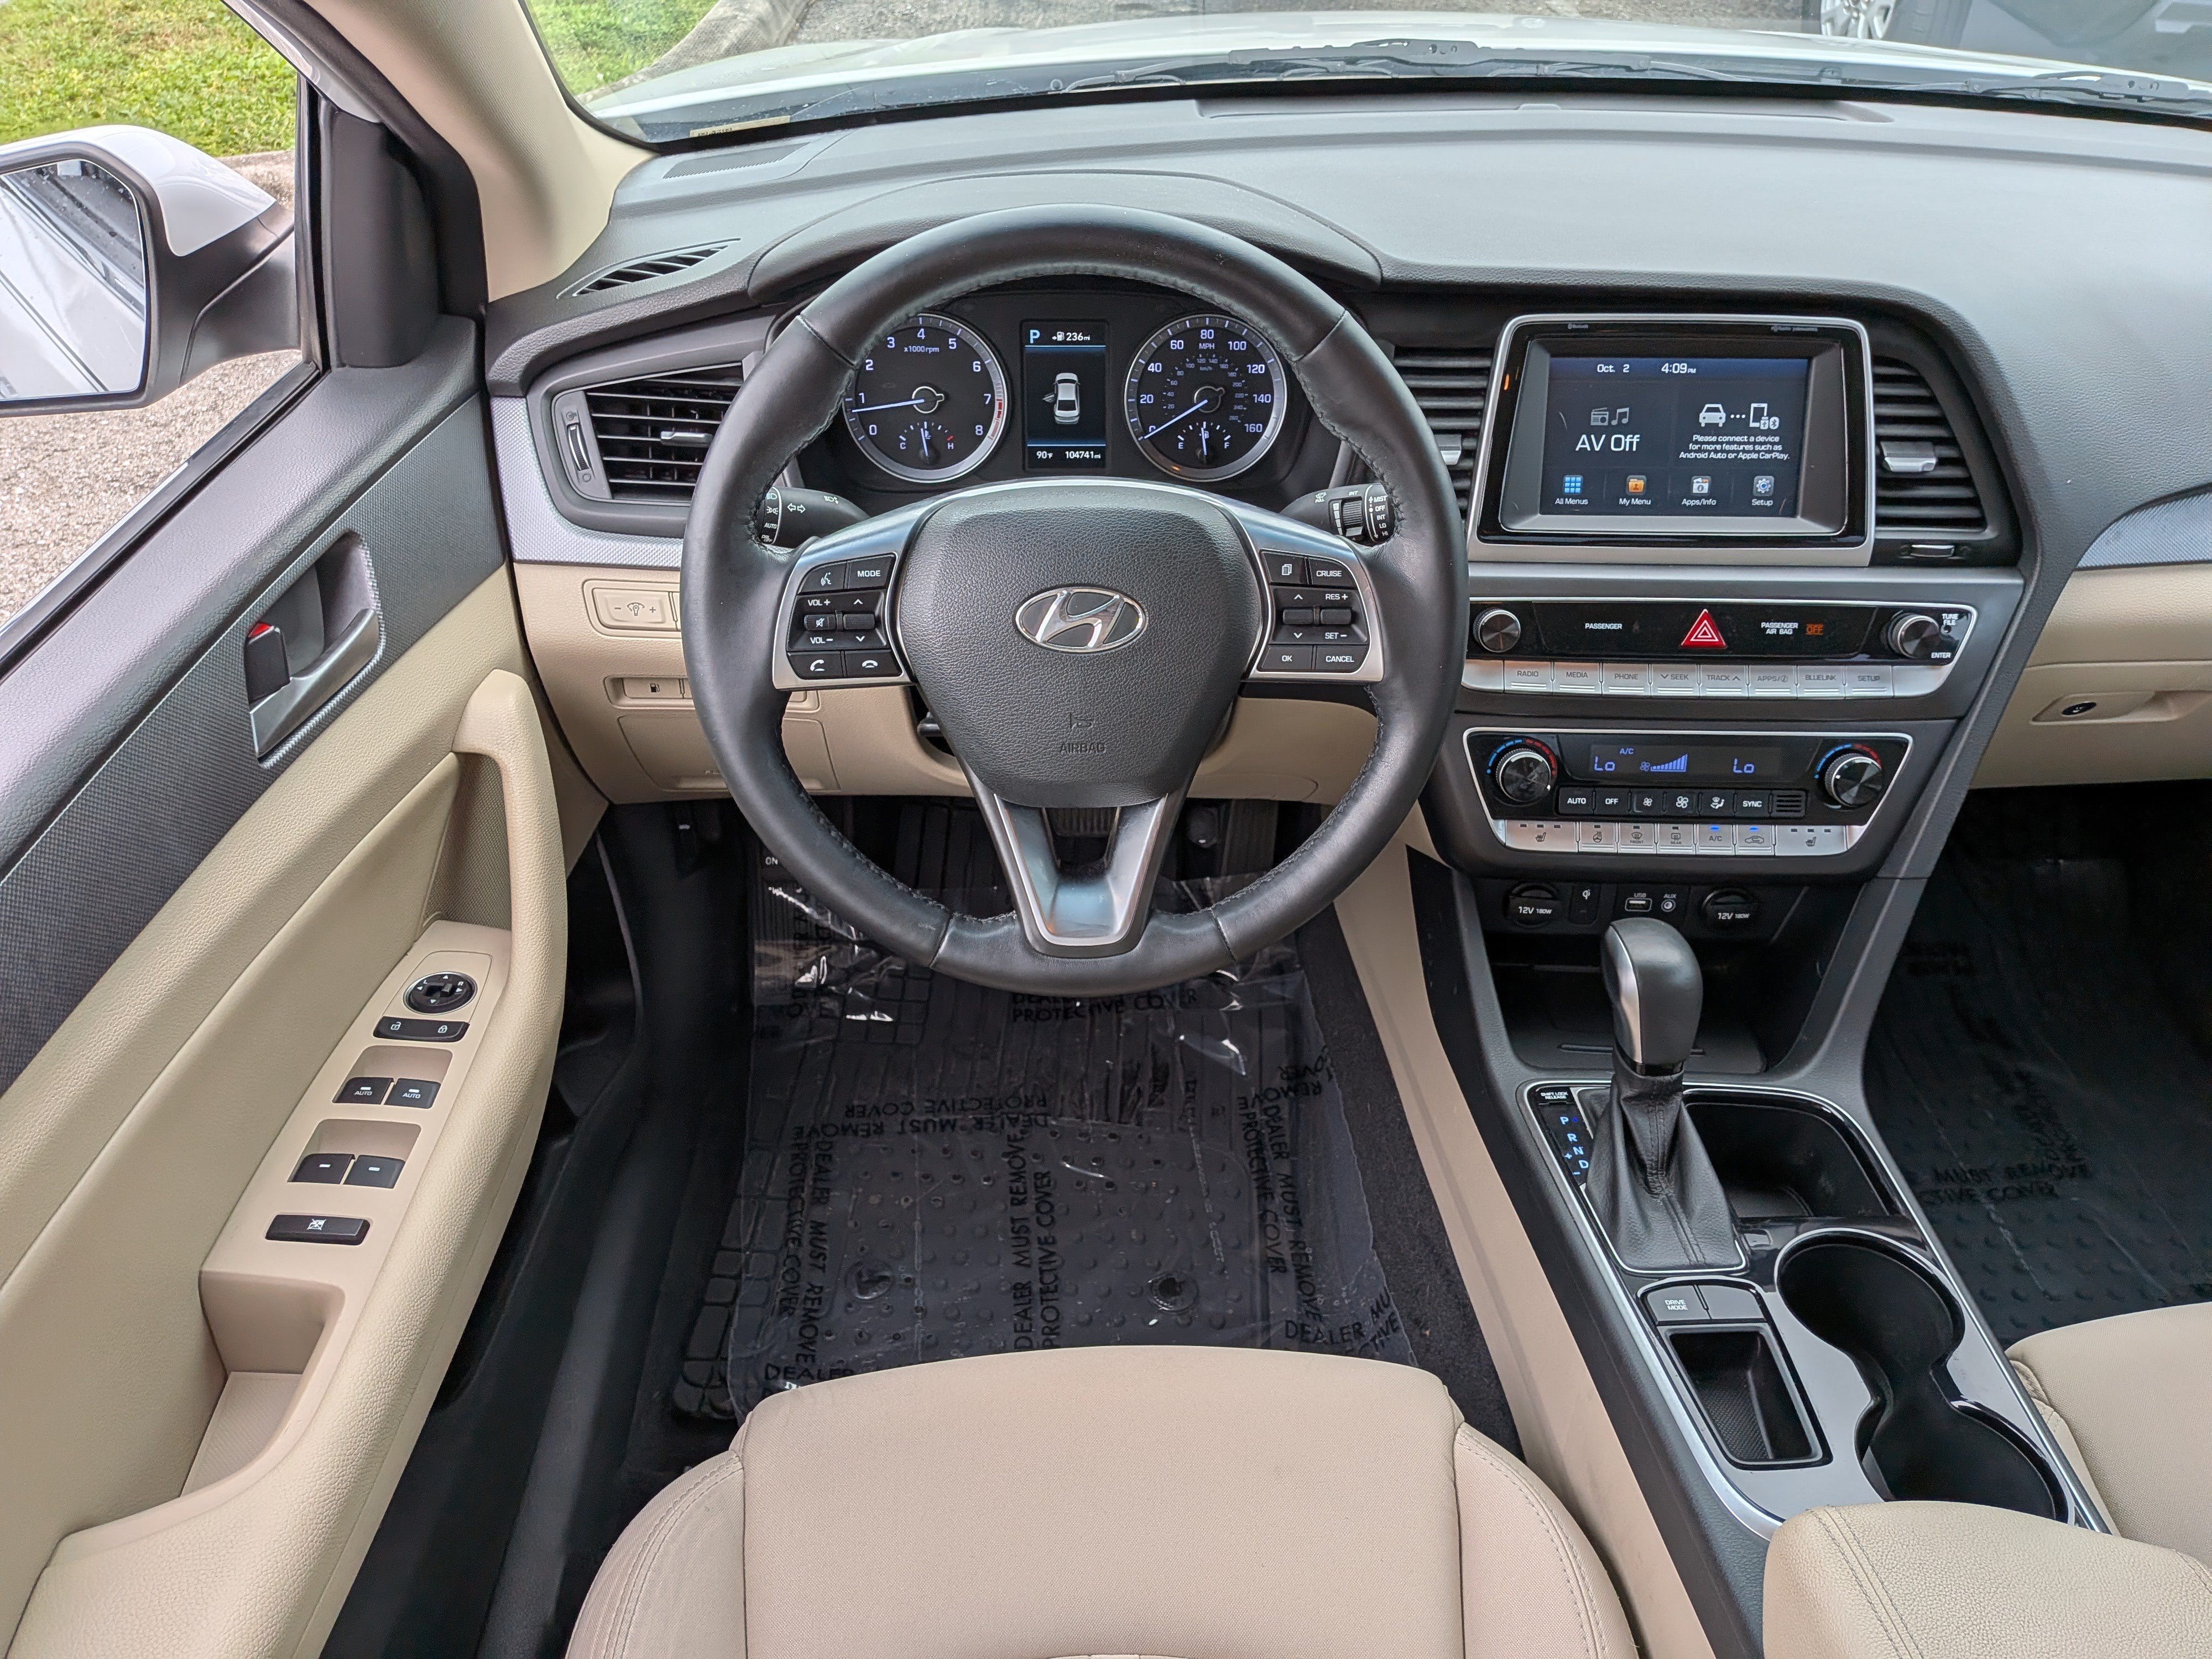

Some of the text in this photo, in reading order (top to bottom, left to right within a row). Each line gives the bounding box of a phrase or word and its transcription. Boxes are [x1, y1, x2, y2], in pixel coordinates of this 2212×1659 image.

[917, 328, 925, 339] 4
[1030, 330, 1040, 343] P
[1201, 330, 1214, 339] 80
[887, 337, 895, 348] 3
[948, 338, 957, 349] 5
[1170, 340, 1184, 349] 60
[1228, 341, 1246, 350] 100
[865, 359, 873, 370] 2
[973, 361, 981, 372] 6
[1147, 363, 1162, 373] 40
[1246, 364, 1265, 373] 120
[1597, 364, 1630, 373] Oct. 2
[859, 393, 864, 403] 1
[983, 394, 992, 404] 7
[1140, 394, 1154, 403] 20
[1253, 394, 1271, 403] 140
[869, 425, 877, 435] 0
[975, 425, 983, 435] 8
[1244, 424, 1262, 432] 160
[1575, 434, 1641, 451] AV Off
[1806, 624, 1823, 635] OFF
[1059, 743, 1105, 754] AIRBAG
[844, 1100, 916, 1118] COVER
[897, 1118, 958, 1134] MUST
[1560, 1117, 1569, 1125] P
[1567, 1133, 1577, 1142] R
[1573, 1146, 1584, 1155] N
[1579, 1160, 1589, 1168] D
[1278, 1173, 1303, 1228] MUST
[1008, 1134, 1033, 1350] DEALER MUST REMOVE
[1259, 1209, 1288, 1274] COVER
[795, 1138, 833, 1365] DEALER MUST REMOVE
[1033, 1170, 1061, 1348] PROTECTIVE COVER
[778, 1255, 802, 1318] COVER
[1289, 1239, 1323, 1323] REMOVE
[1285, 1319, 1365, 1345] DEALER
